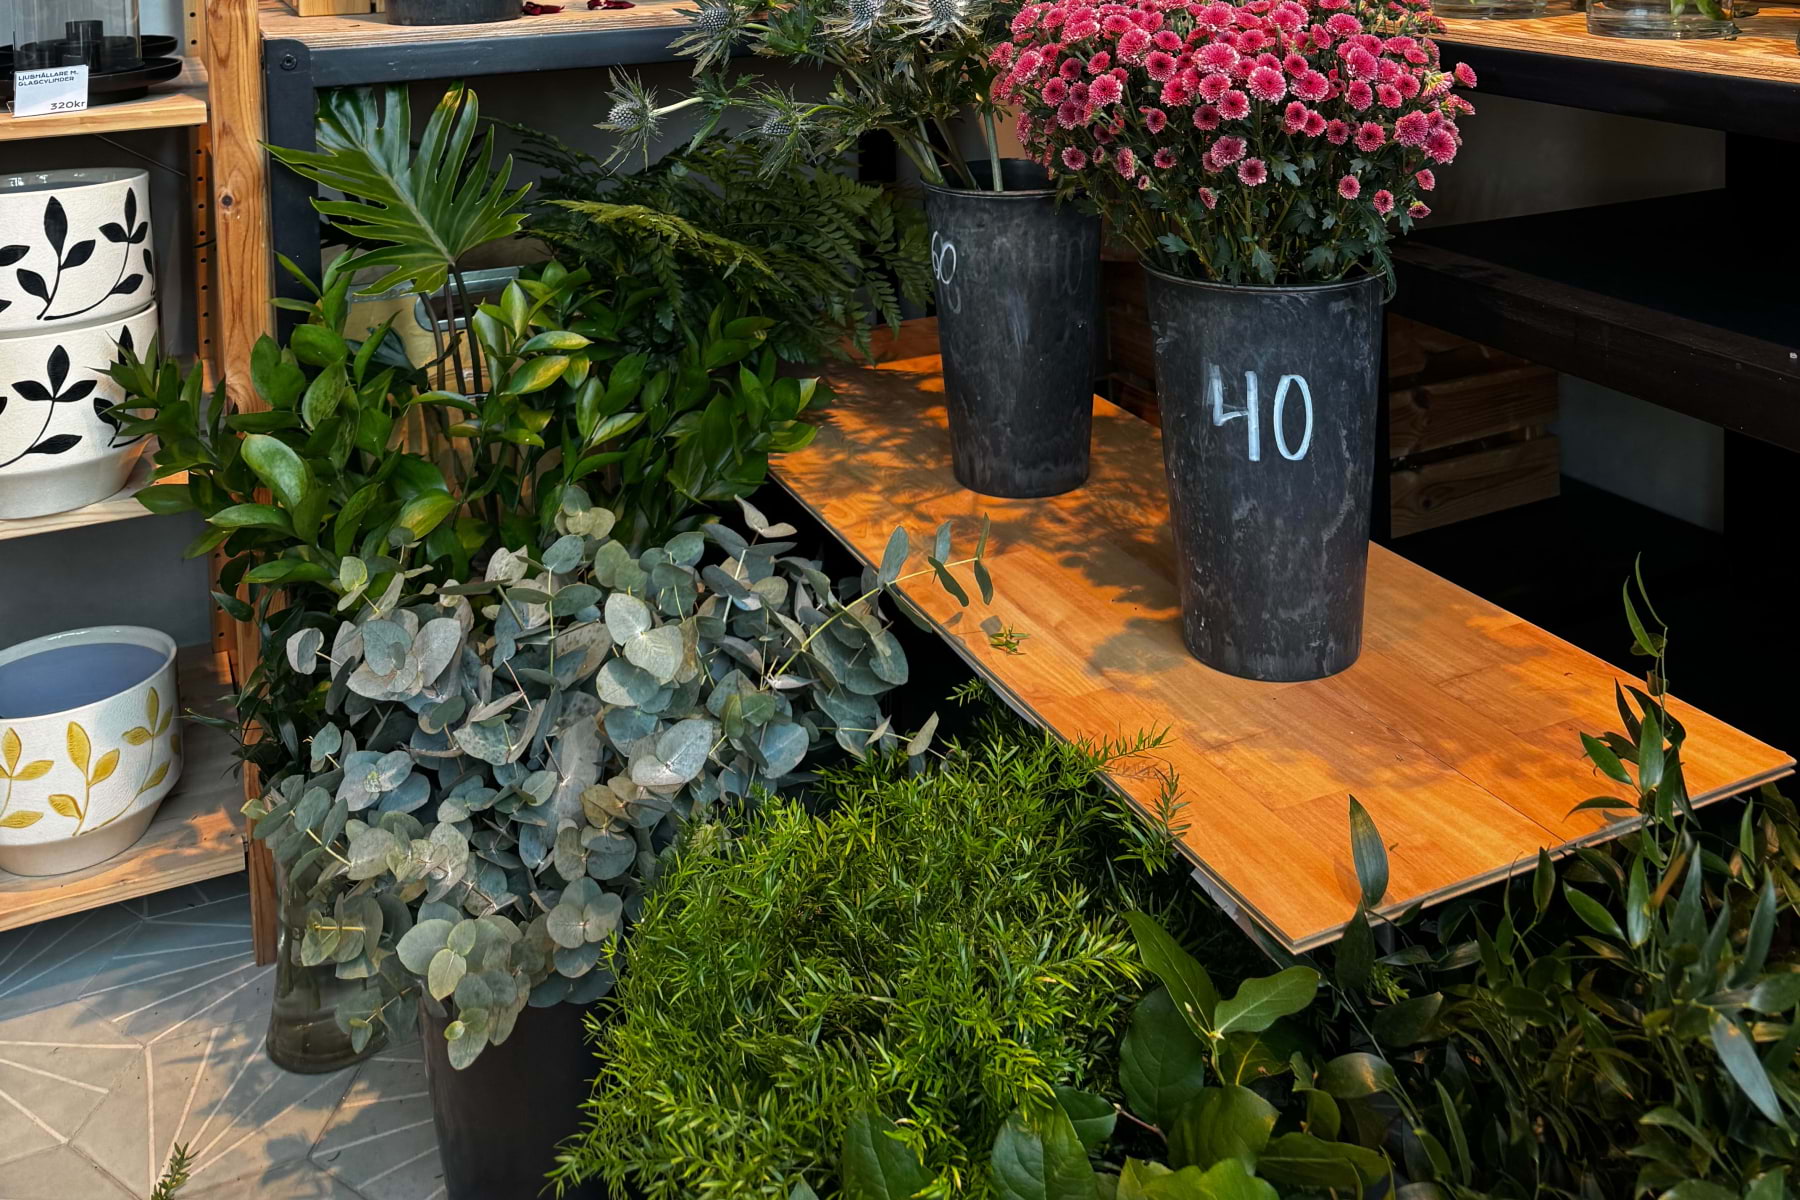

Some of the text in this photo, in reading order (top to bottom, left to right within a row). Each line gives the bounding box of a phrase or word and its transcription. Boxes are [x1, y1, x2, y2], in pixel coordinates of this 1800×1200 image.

[18, 70, 69, 81] LJUSHÅLLARE
[18, 76, 75, 86] GLASCYLINDER
[50, 100, 86, 110] 320kr
[1211, 364, 1314, 462] 40
